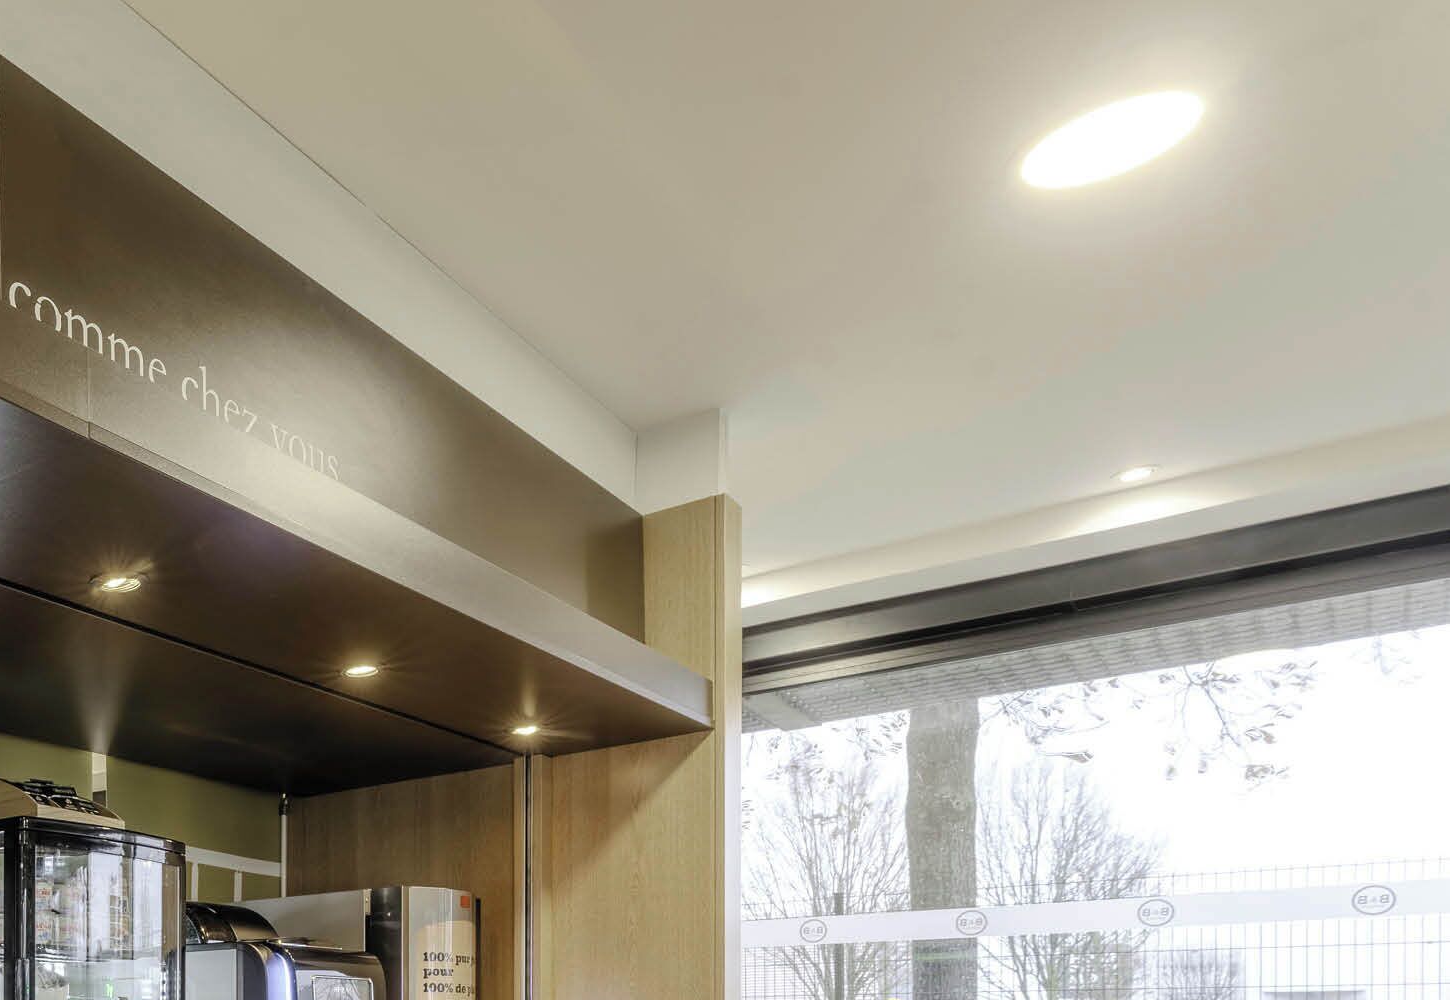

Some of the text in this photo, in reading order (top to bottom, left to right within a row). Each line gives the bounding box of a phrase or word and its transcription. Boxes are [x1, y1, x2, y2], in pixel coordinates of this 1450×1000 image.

[8, 281, 167, 383] comme
[423, 951, 453, 962] 100%
[423, 967, 454, 979] pour
[423, 982, 454, 993] 100%
